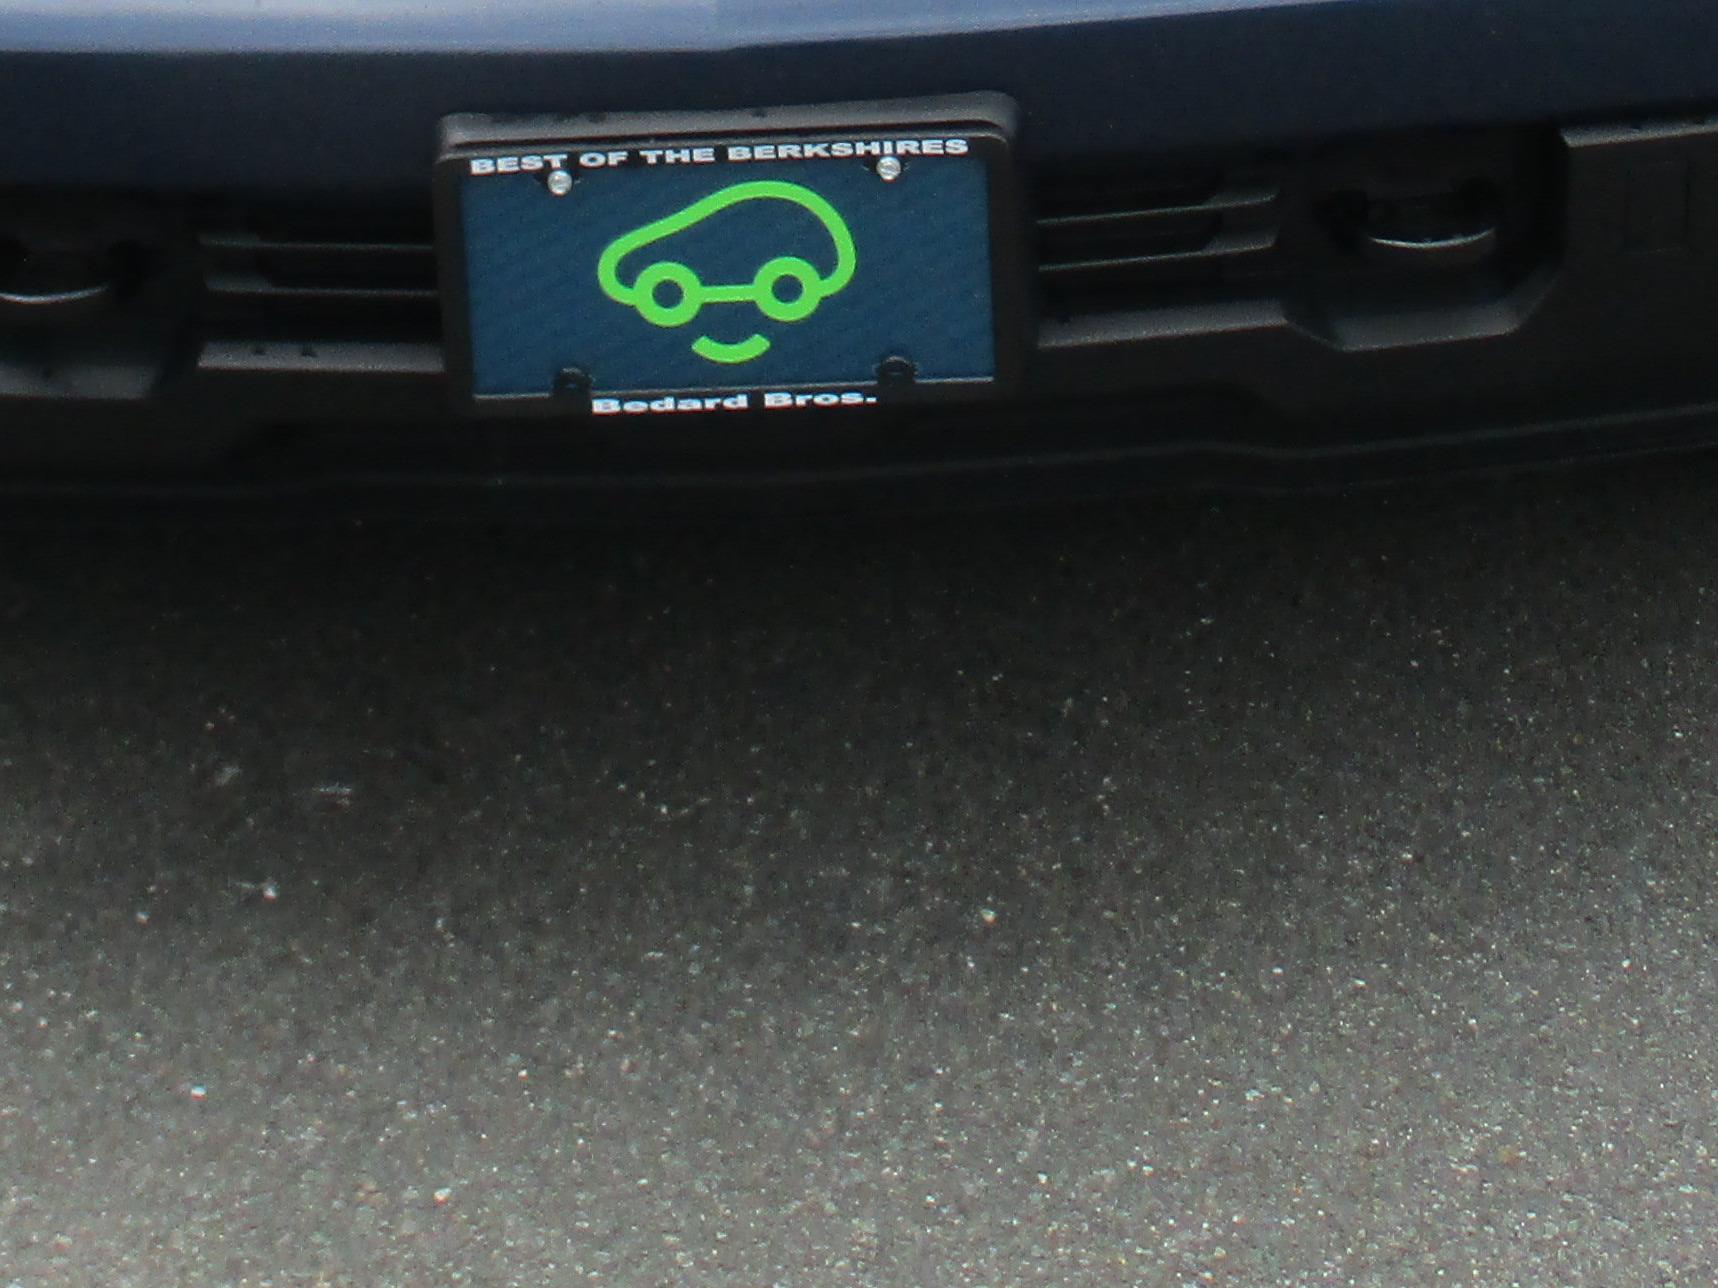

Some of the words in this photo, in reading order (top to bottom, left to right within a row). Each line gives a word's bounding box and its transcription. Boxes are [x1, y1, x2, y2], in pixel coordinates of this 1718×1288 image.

[470, 154, 568, 175] BEST
[579, 150, 628, 167] OF
[639, 147, 715, 164] THE
[727, 138, 969, 162] BERKSHIRES
[591, 393, 748, 415] Bedard
[763, 391, 877, 409] Bros.
